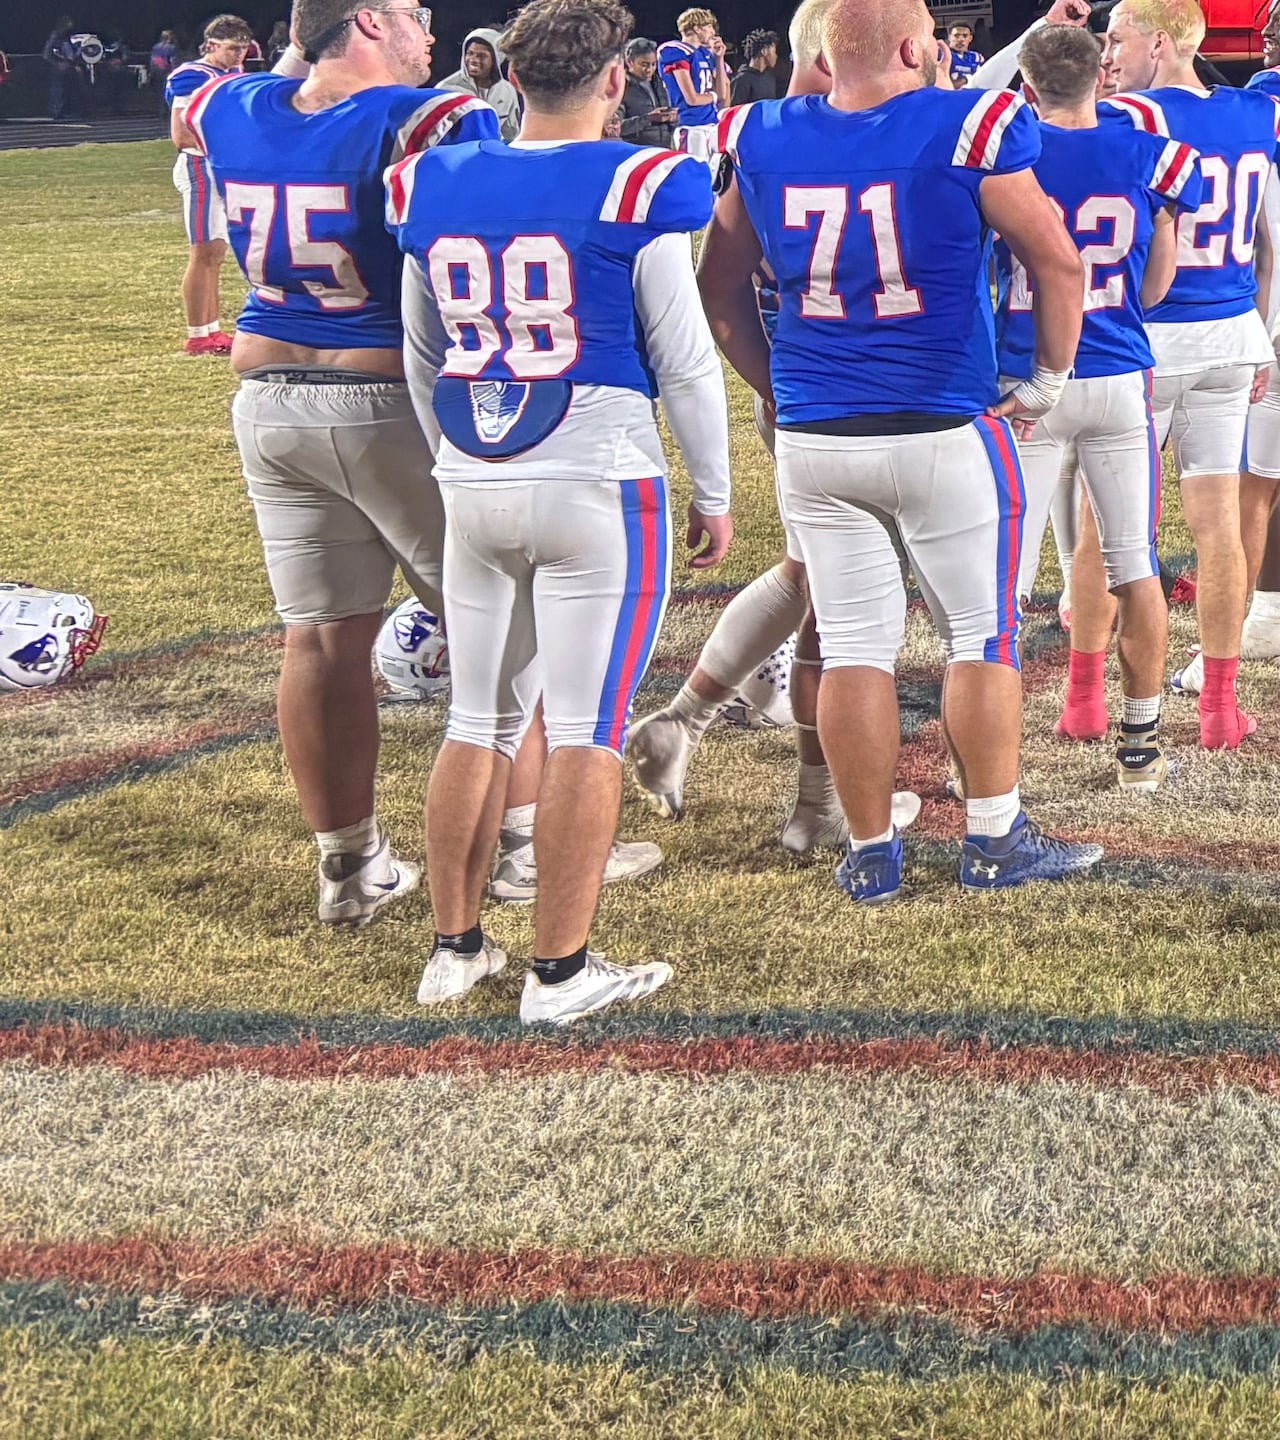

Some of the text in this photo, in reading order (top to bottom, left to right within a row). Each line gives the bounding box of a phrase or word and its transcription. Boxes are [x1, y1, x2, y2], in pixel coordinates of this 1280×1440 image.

[224, 180, 370, 311] 75
[783, 182, 924, 319] 71
[1173, 150, 1270, 267] 20
[427, 233, 582, 379] 88
